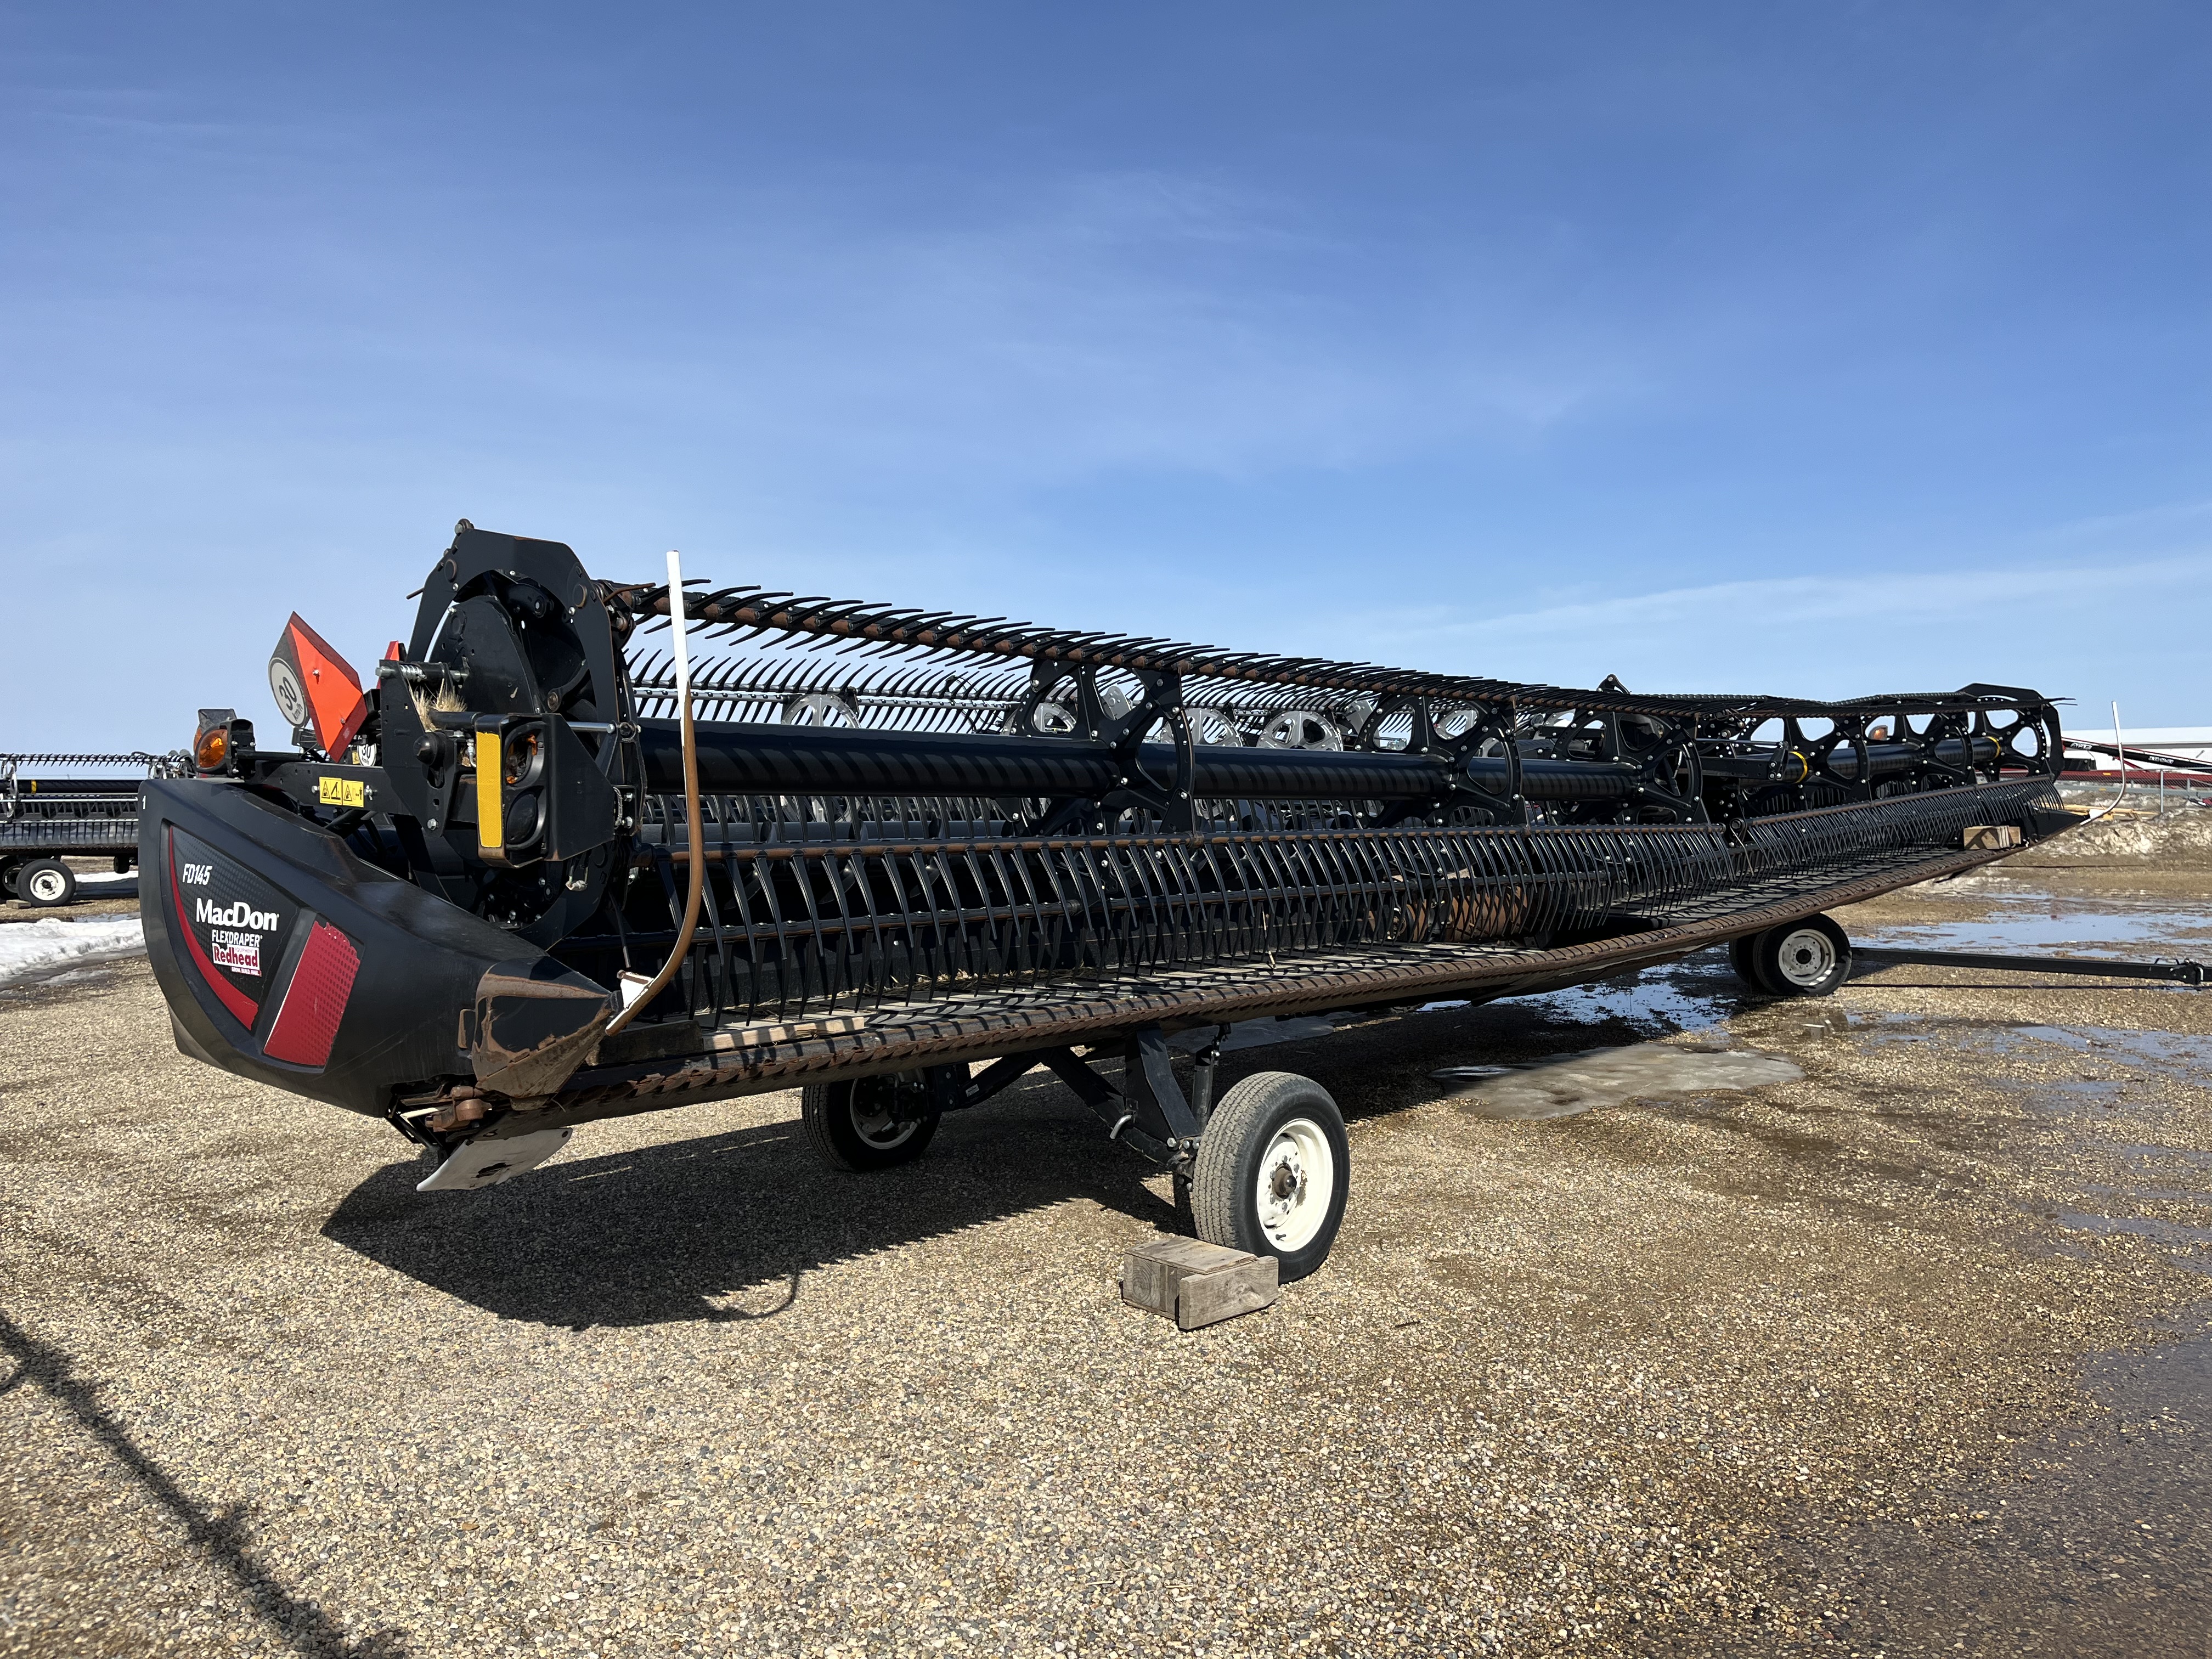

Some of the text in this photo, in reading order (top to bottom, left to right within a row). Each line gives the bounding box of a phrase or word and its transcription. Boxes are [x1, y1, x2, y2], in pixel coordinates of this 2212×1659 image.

[279, 676, 297, 710] 30
[292, 703, 303, 721] km/h
[362, 743, 371, 759] 30
[142, 795, 146, 810] 1
[182, 863, 213, 885] FD145
[196, 898, 278, 932] MacDon
[212, 929, 260, 947] FLEXDRAPER
[213, 945, 258, 968] Redhead
